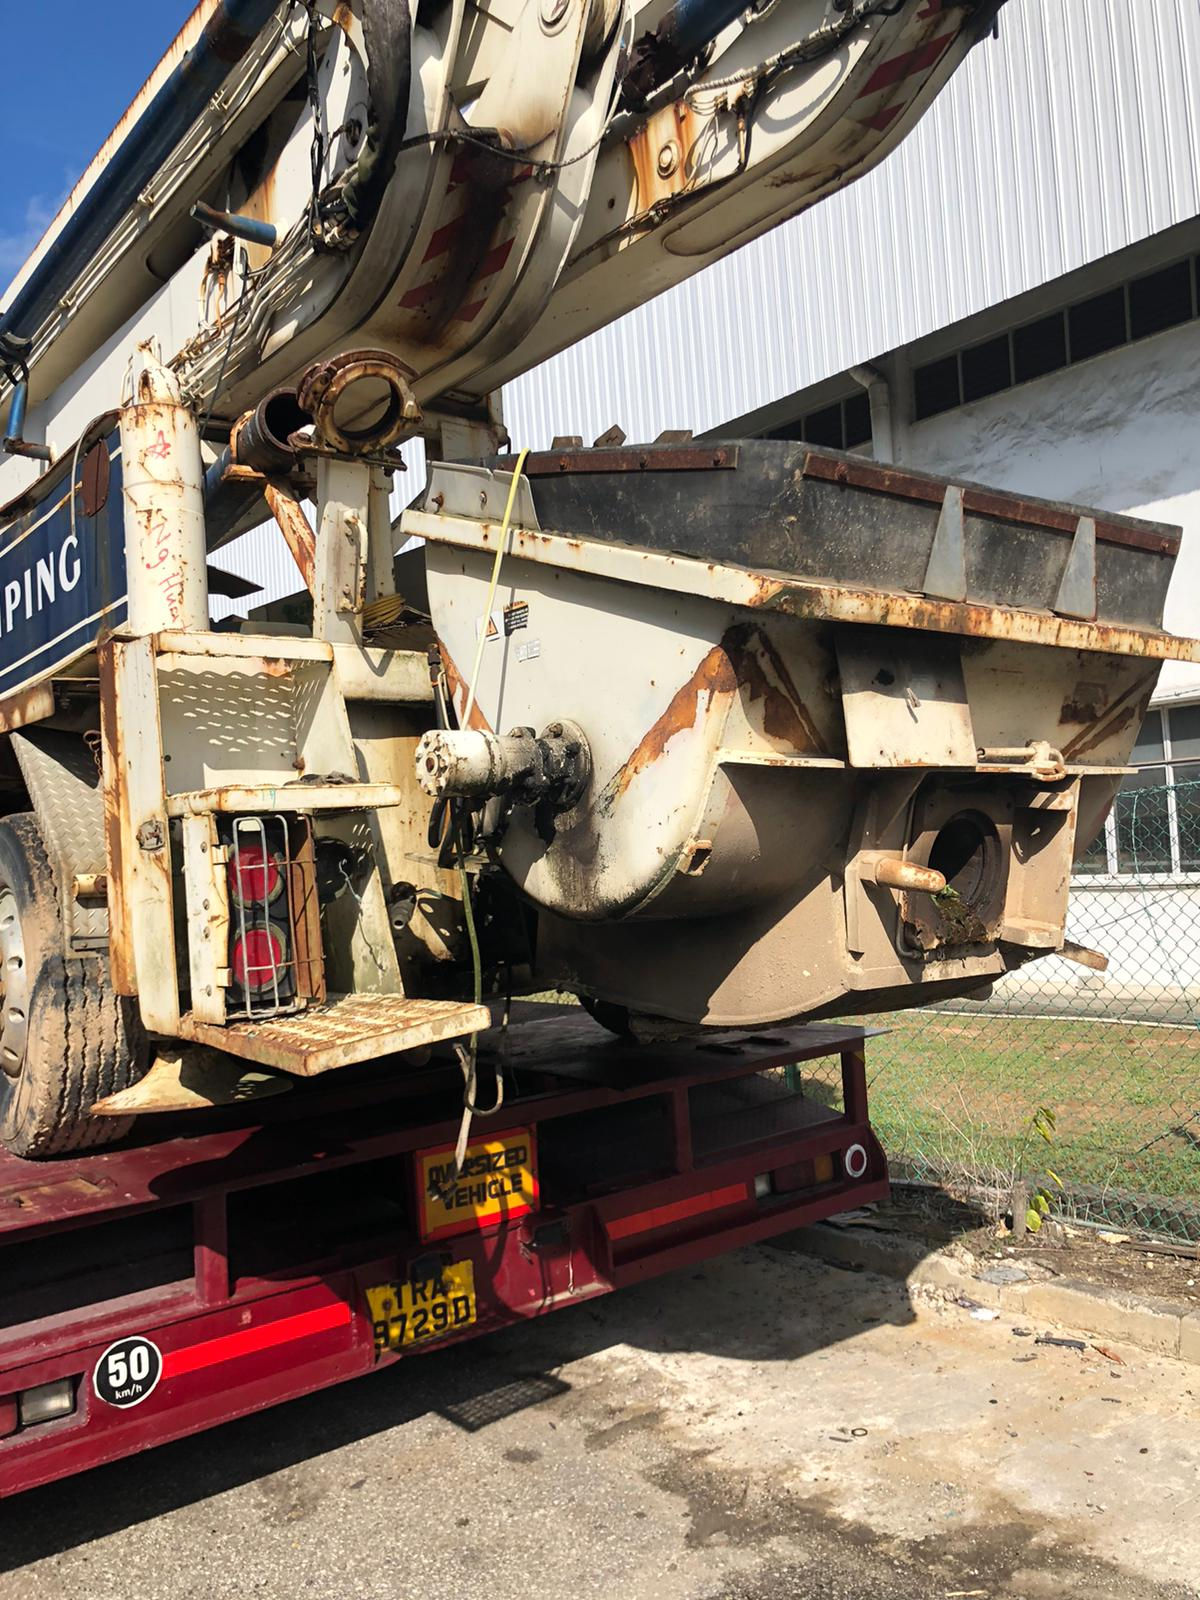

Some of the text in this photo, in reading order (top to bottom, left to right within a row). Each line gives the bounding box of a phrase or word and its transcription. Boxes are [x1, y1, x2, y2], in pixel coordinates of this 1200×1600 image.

[0, 535, 81, 638] PING
[428, 1145, 527, 1184] OVRSIZED
[108, 1345, 150, 1388] 50
[115, 1383, 143, 1400] km/h
